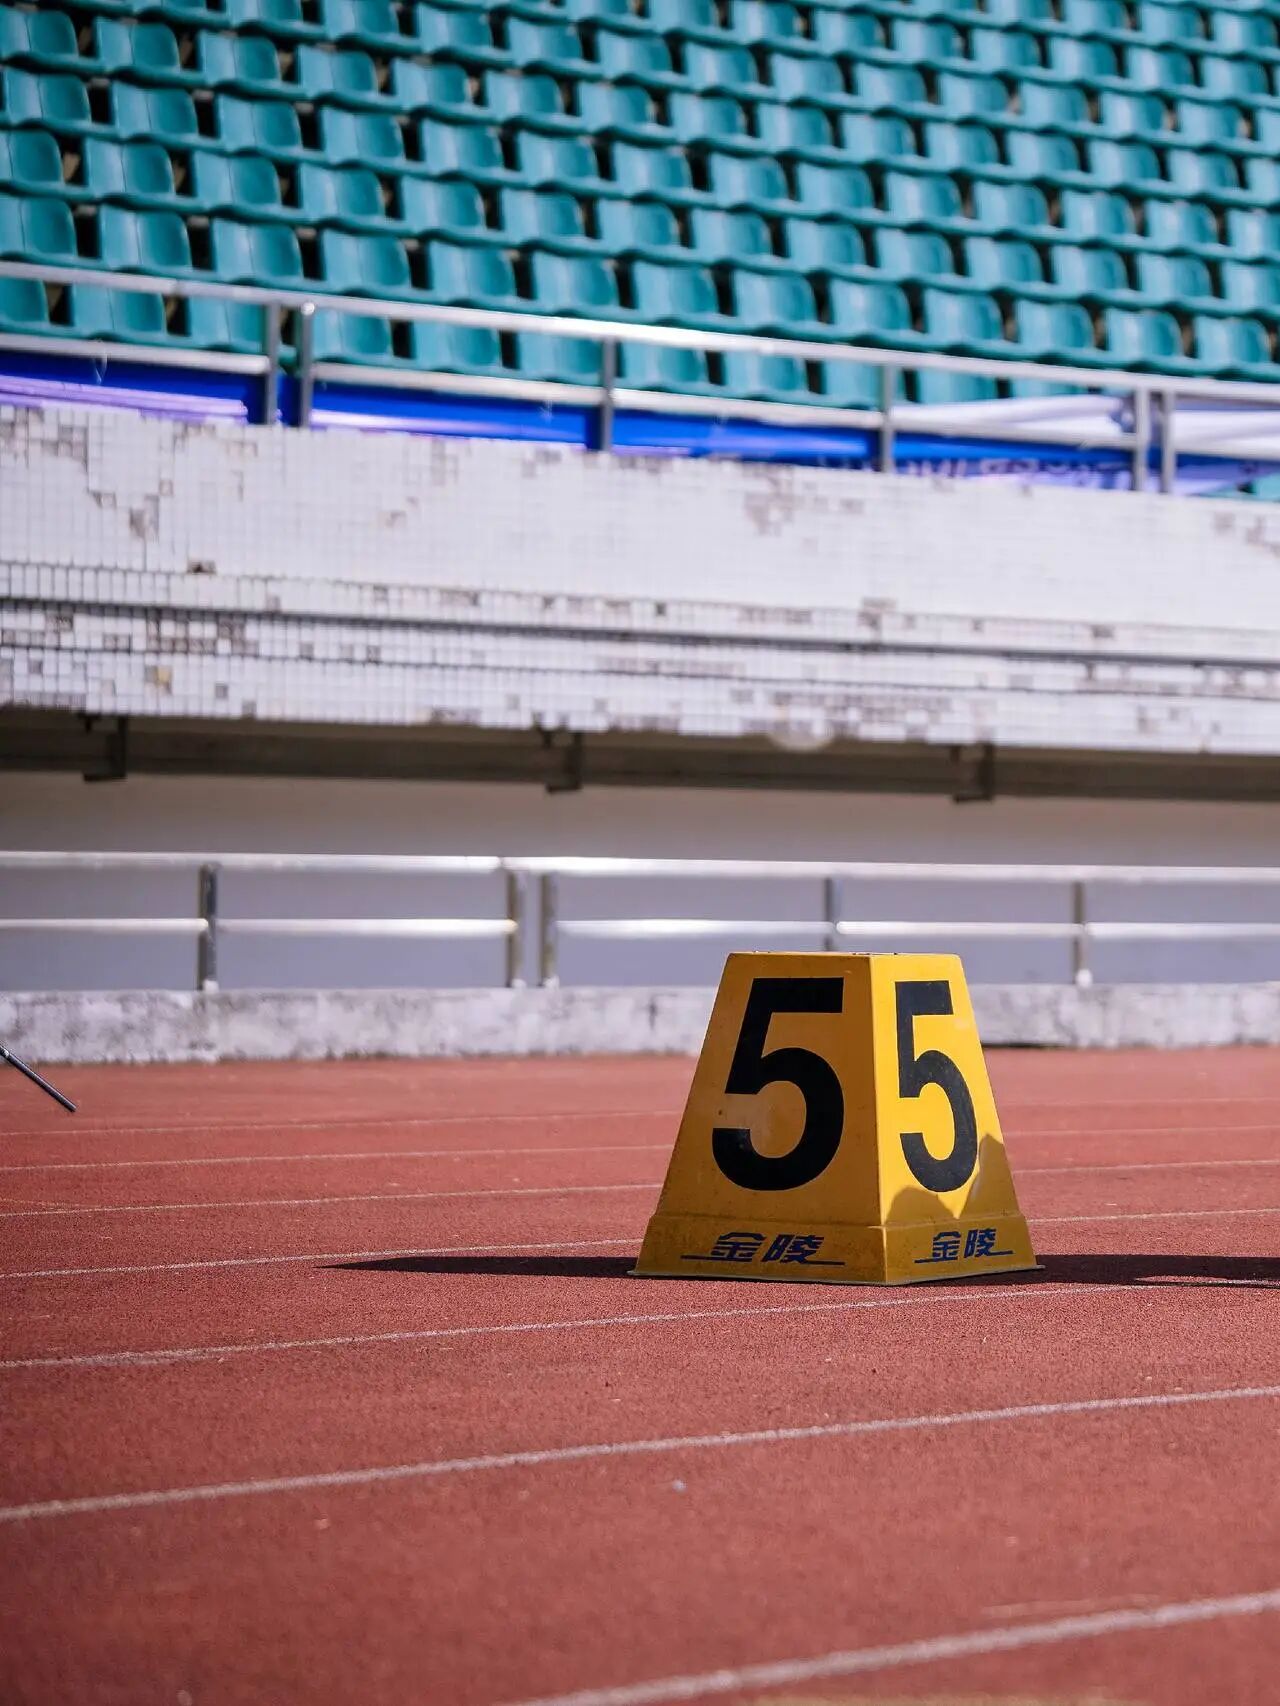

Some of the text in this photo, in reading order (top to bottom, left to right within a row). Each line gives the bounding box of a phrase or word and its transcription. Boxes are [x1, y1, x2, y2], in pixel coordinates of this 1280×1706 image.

[711, 976, 845, 1191] 5
[894, 980, 979, 1193] 5
[707, 1230, 826, 1264] 金陵
[930, 1227, 998, 1261] 金陵
